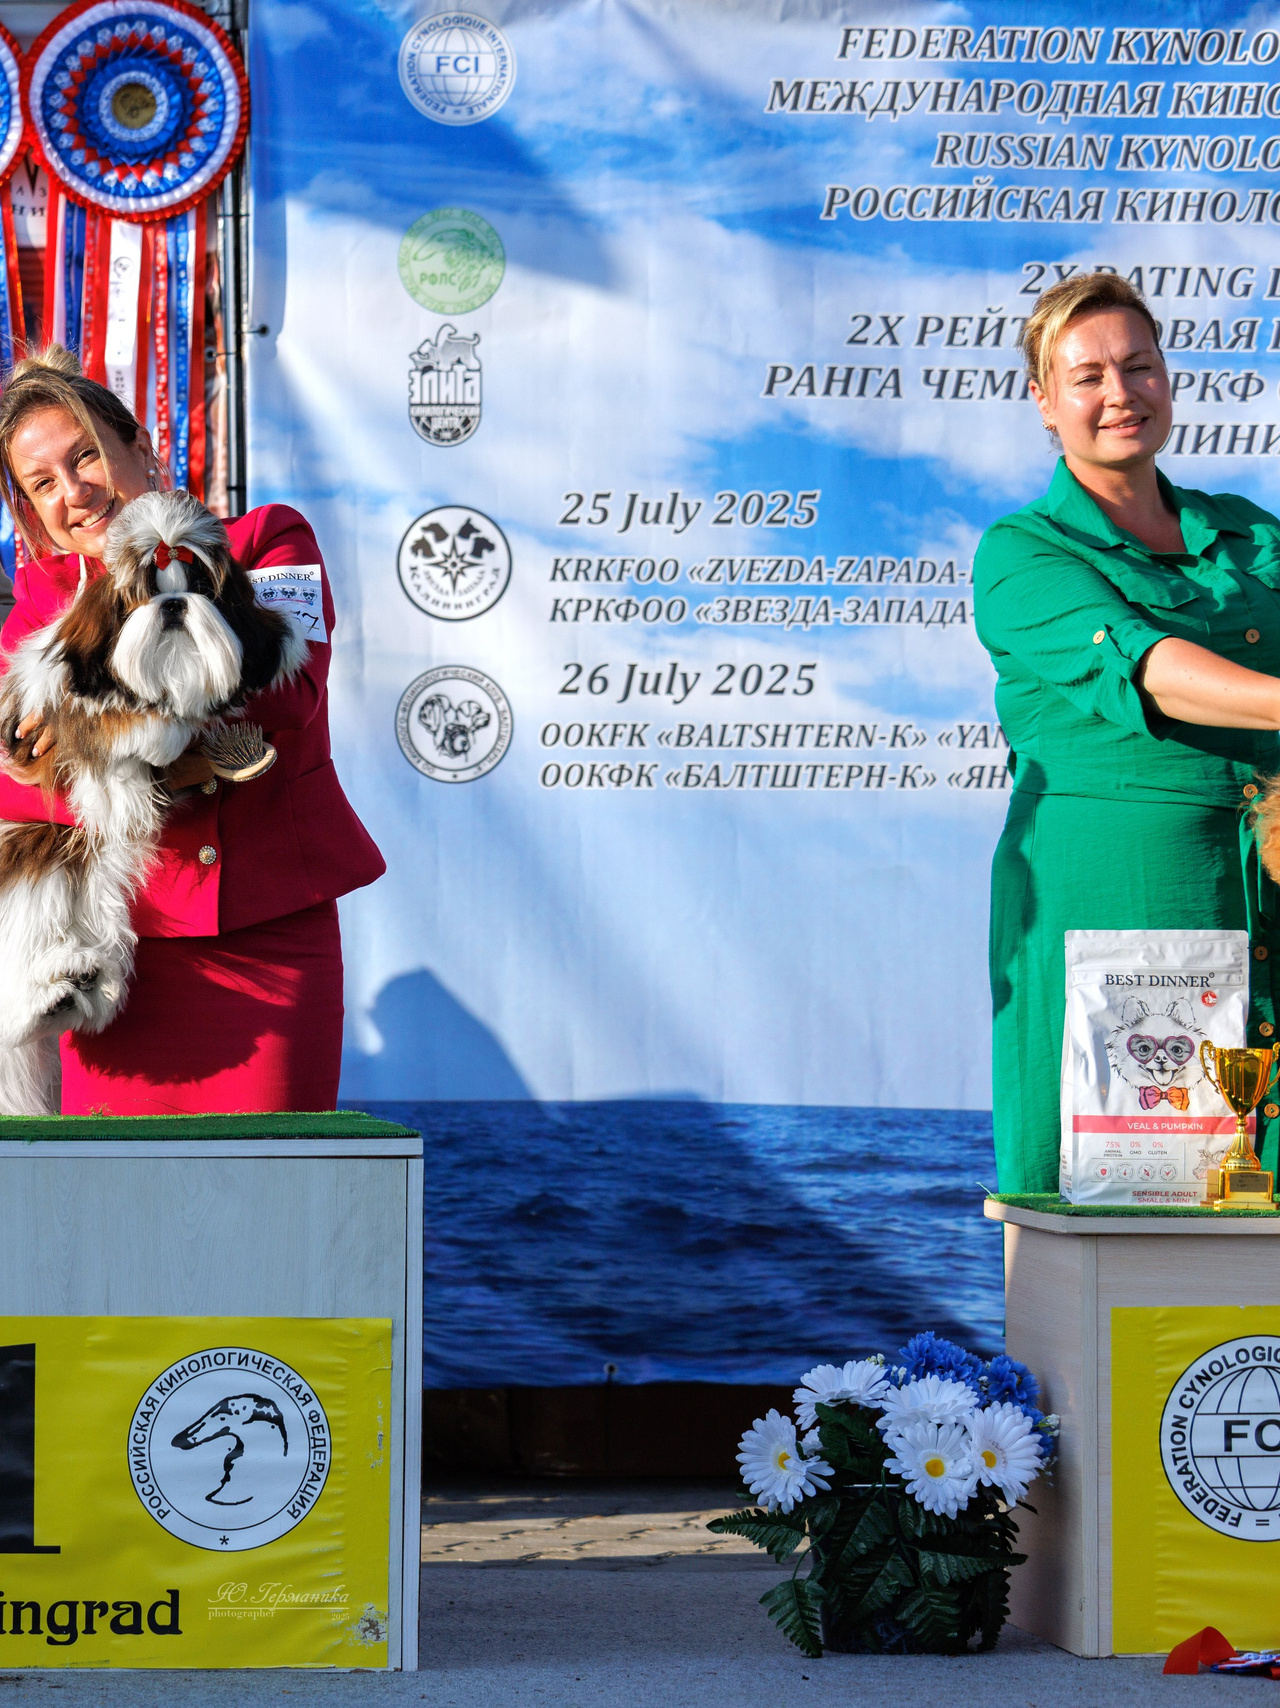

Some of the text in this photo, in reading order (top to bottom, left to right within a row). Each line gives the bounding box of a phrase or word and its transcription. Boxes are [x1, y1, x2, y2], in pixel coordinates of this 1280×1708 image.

[838, 27, 1102, 61] FEDERATION
[407, 16, 509, 116] FEDERATION CYNOLOGIQUE INTERNATIONALE
[435, 56, 479, 74] FCI
[767, 81, 1162, 122] МЕЖДУНАРОДНАЯ
[933, 133, 1112, 169] RUSSIAN
[821, 176, 1105, 221] РОССИЙСКАЯ
[764, 365, 902, 399] РАНГА
[560, 492, 818, 534] 25 July 2025
[269, 572, 311, 582] DINNER
[549, 558, 679, 583] KRKFOO
[549, 598, 686, 623] КРКФОО
[559, 662, 817, 705] 26 July 2025
[541, 722, 650, 748] OOKFK
[541, 763, 658, 788] ООКФК
[666, 763, 936, 789] «БАЛТШТЕРН-К»
[1105, 973, 1210, 988] BEST DINNER
[1127, 1122, 1203, 1130] VEAL & PUMPKIN
[129, 1352, 327, 1520] РОССИЙСКАЯ КИНОЛОГИЧЕСКАЯ ФЕДЕРАЦИЯ
[1170, 1413, 1243, 1529] FEDERATION
